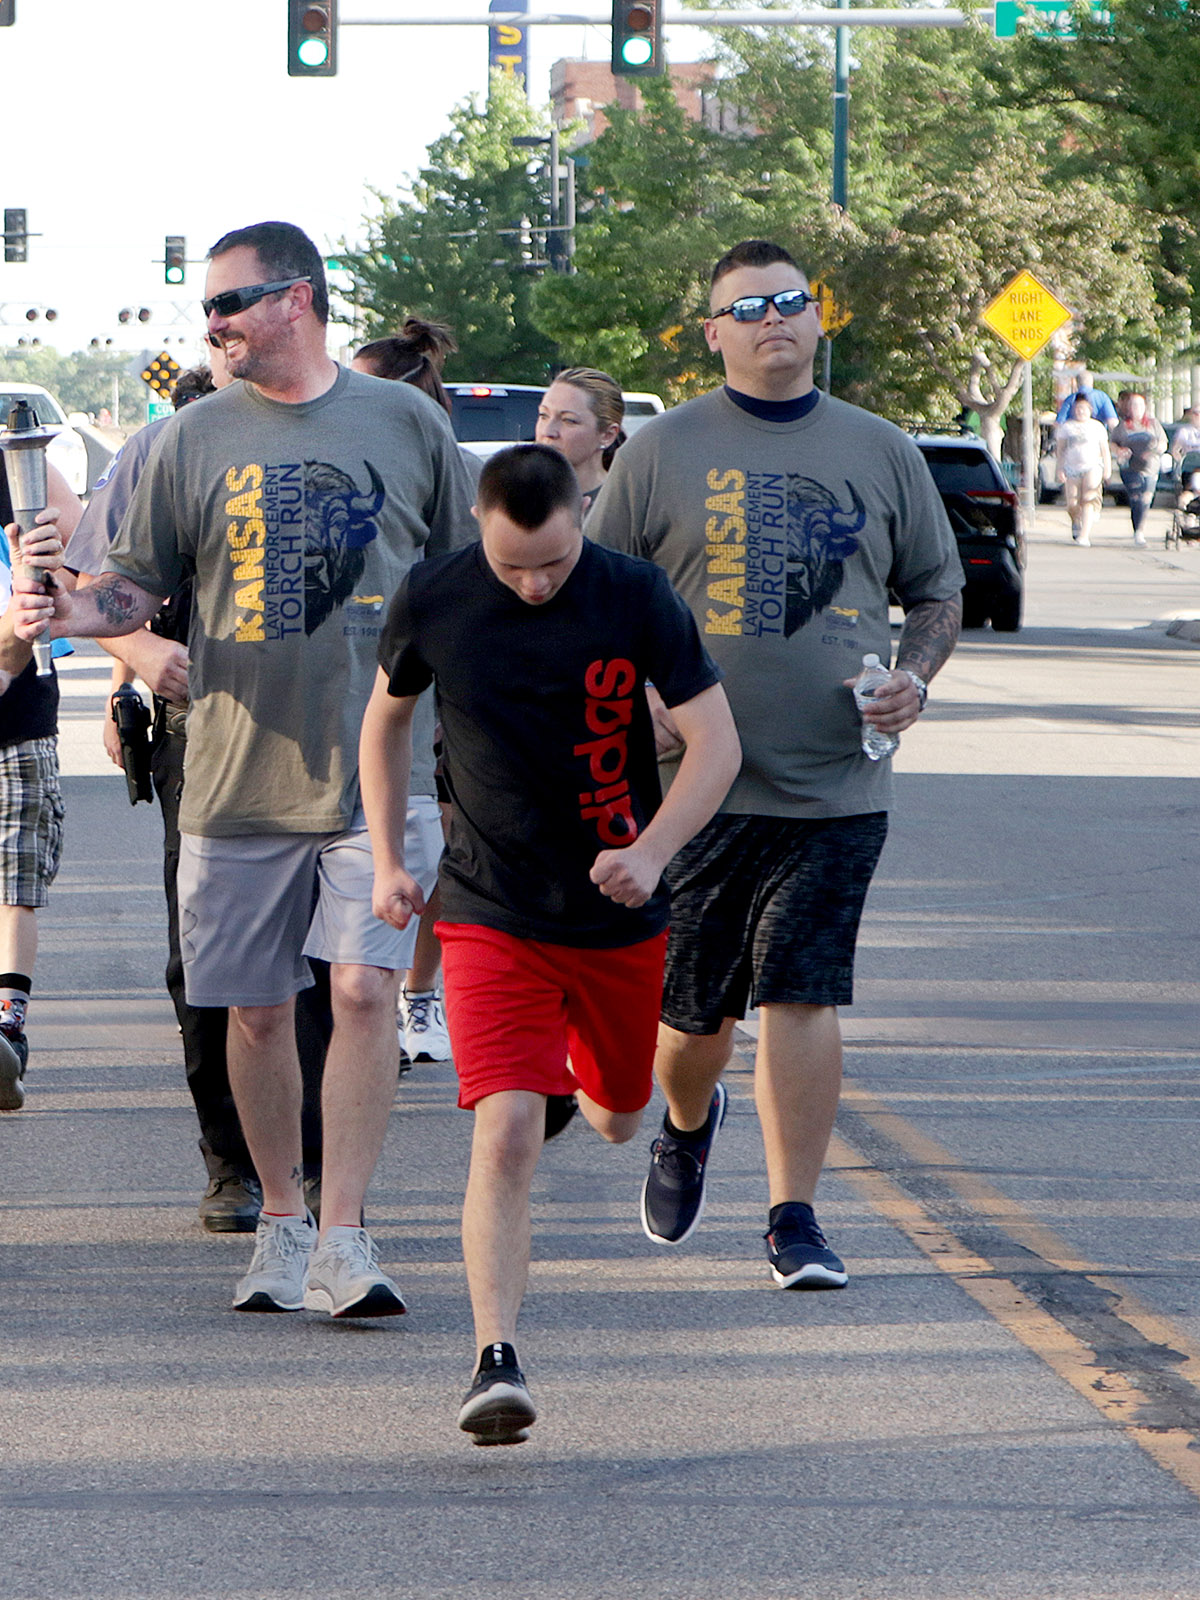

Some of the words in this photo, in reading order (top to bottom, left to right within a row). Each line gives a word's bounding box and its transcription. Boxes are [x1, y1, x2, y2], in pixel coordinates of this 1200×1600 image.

[1009, 293, 1044, 305] RIGHT
[1011, 310, 1042, 322] LANE
[1012, 328, 1044, 340] ENDS
[264, 464, 281, 596] ENFORCEMENT
[279, 464, 303, 526] RUN
[746, 471, 761, 593] ENFORCEMENT
[762, 472, 785, 529] RUN
[225, 463, 266, 642] KANSAS
[280, 531, 303, 640] TORCH
[704, 467, 747, 636] KANSAS
[757, 537, 785, 637] TORCH
[265, 601, 280, 640] LAW
[743, 598, 760, 636] LAW
[573, 658, 638, 846] didas
